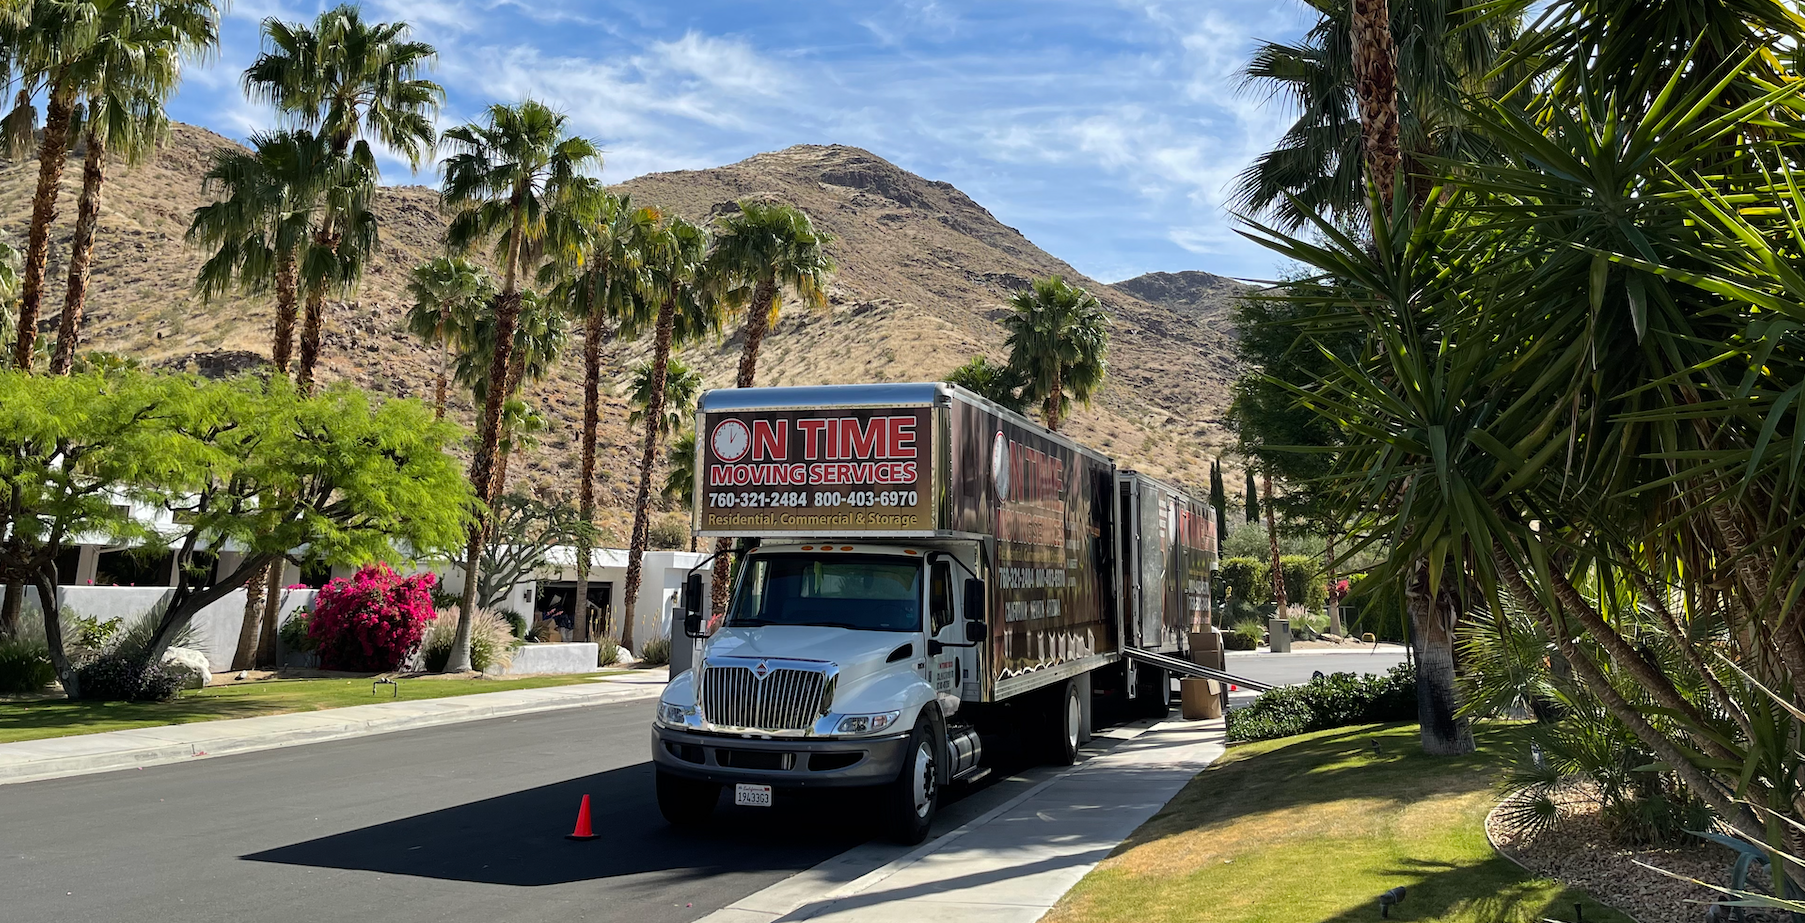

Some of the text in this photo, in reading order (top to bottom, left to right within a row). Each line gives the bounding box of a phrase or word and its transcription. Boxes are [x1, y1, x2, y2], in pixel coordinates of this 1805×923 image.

[711, 416, 918, 462] ON TIME
[710, 461, 918, 486] MOVING SERVICES
[709, 490, 918, 508] 760-321-2484 800-403-6970
[709, 512, 918, 528] Residential, Commercial & Storage
[738, 792, 769, 803] 19433G3
